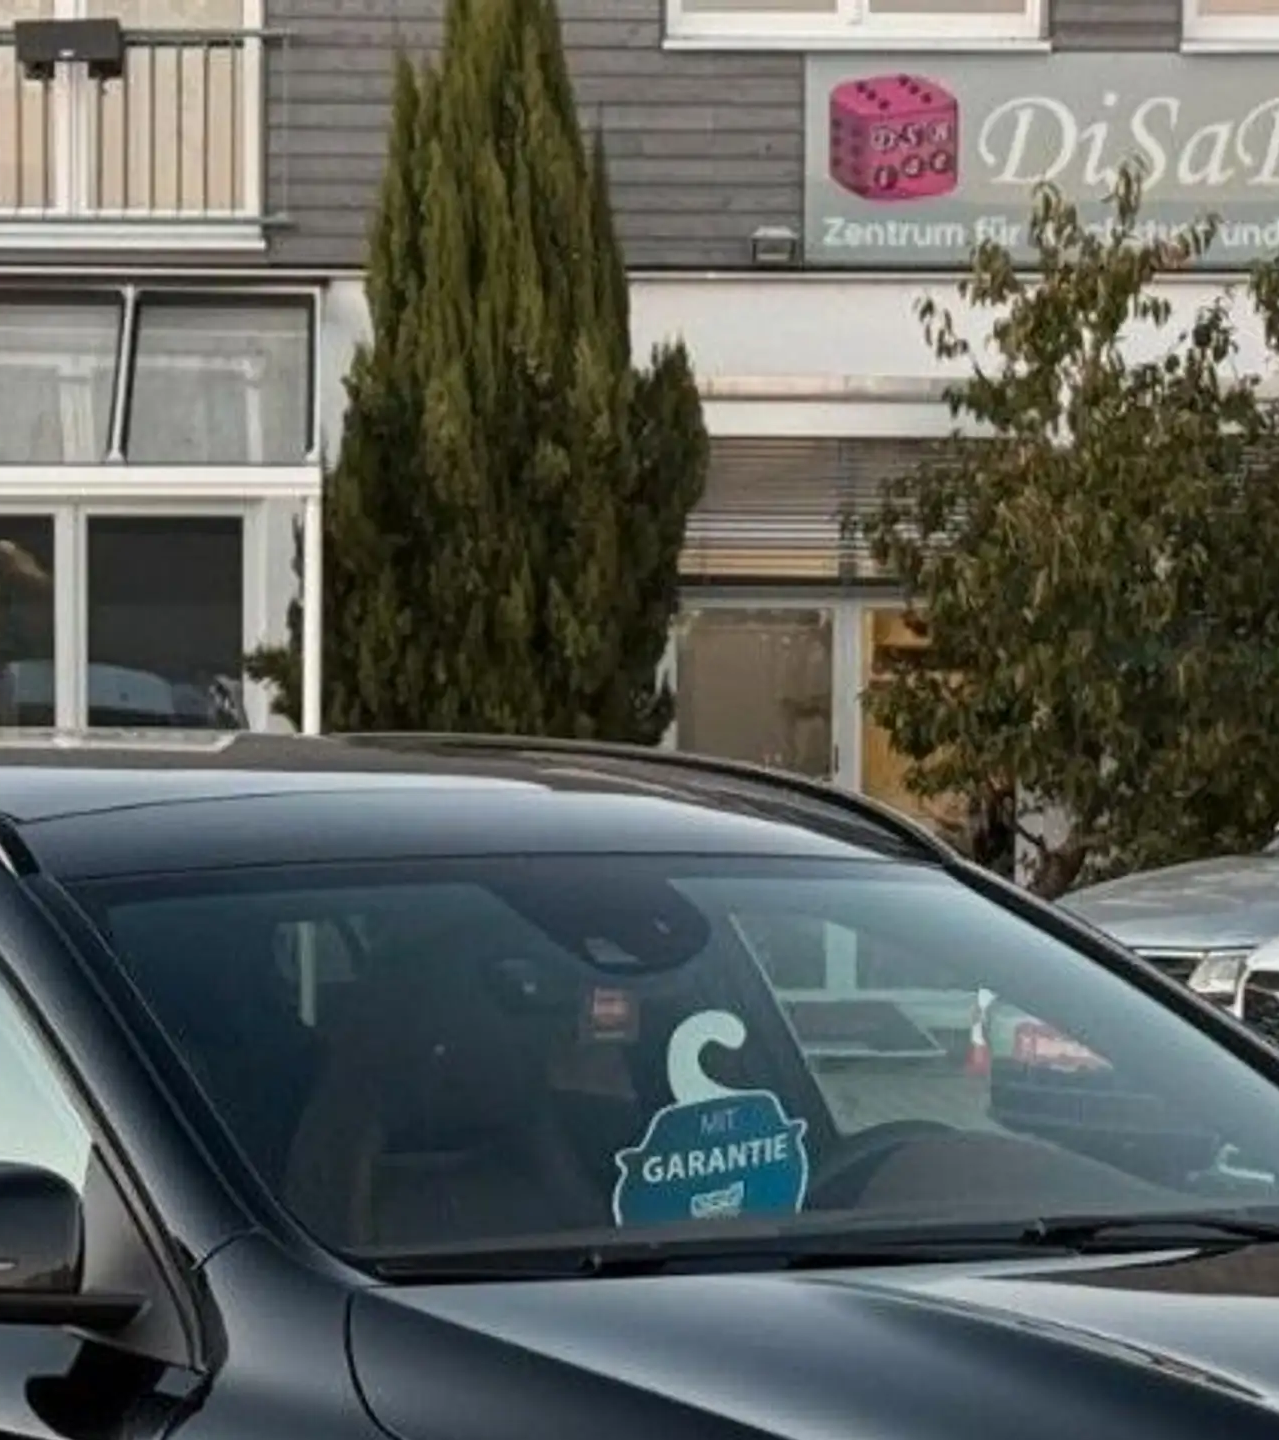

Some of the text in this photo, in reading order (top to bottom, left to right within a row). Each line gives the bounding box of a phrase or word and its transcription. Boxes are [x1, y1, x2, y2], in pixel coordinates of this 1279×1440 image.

[823, 217, 964, 248] Zentrum
[976, 214, 1018, 247] für
[642, 1132, 789, 1183] GARANTIE
